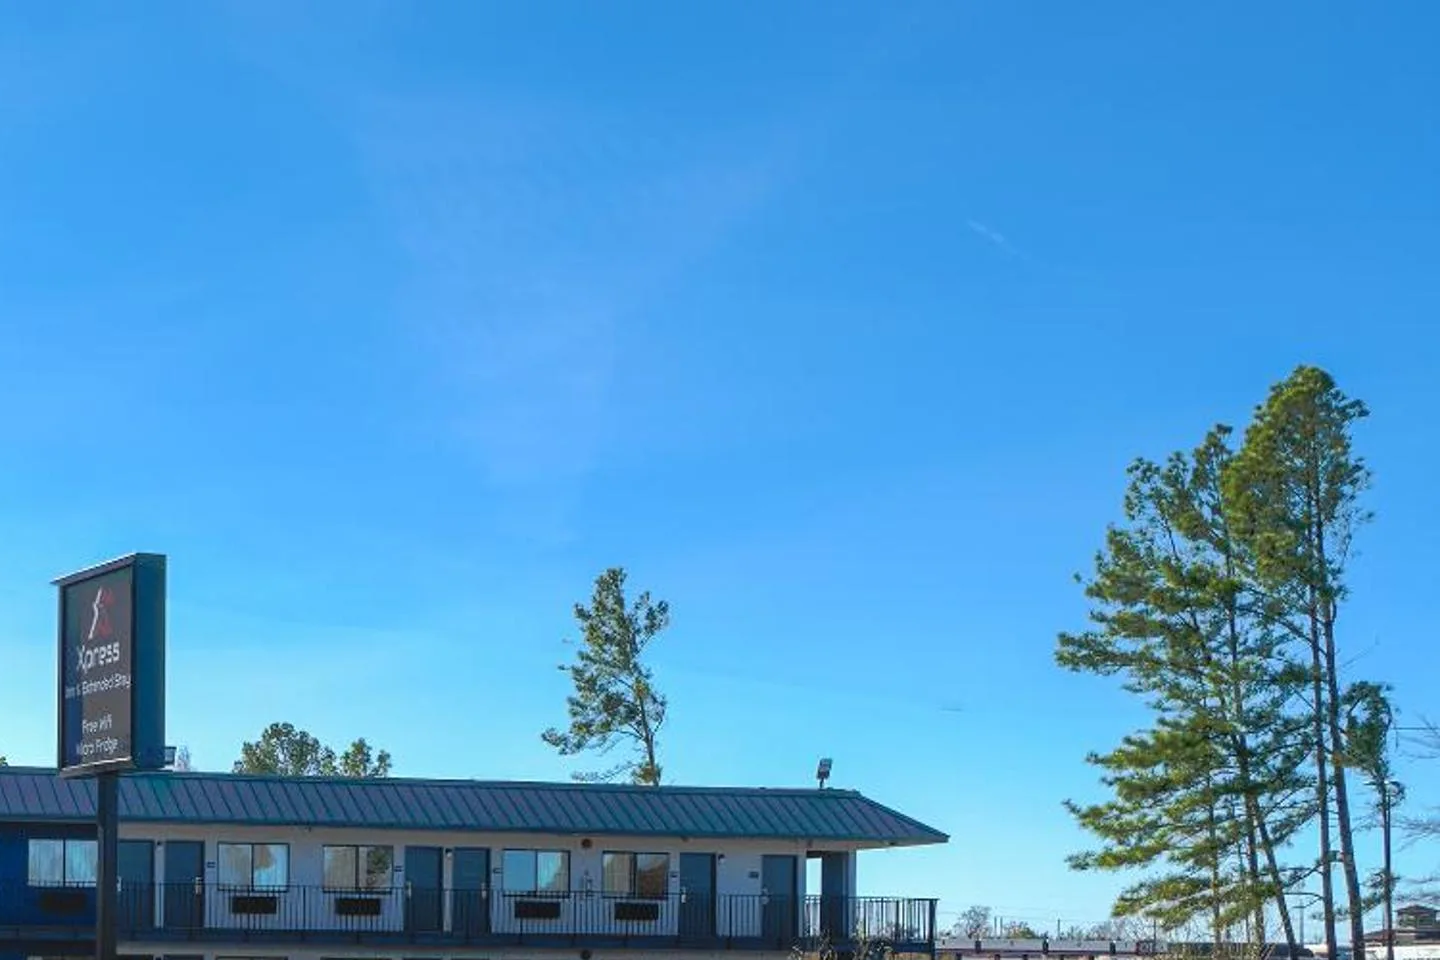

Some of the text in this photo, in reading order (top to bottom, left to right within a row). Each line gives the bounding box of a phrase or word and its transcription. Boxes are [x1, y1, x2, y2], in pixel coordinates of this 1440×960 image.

[76, 642, 120, 674] Xpress
[82, 677, 113, 695] Extended
[82, 719, 98, 734] Free
